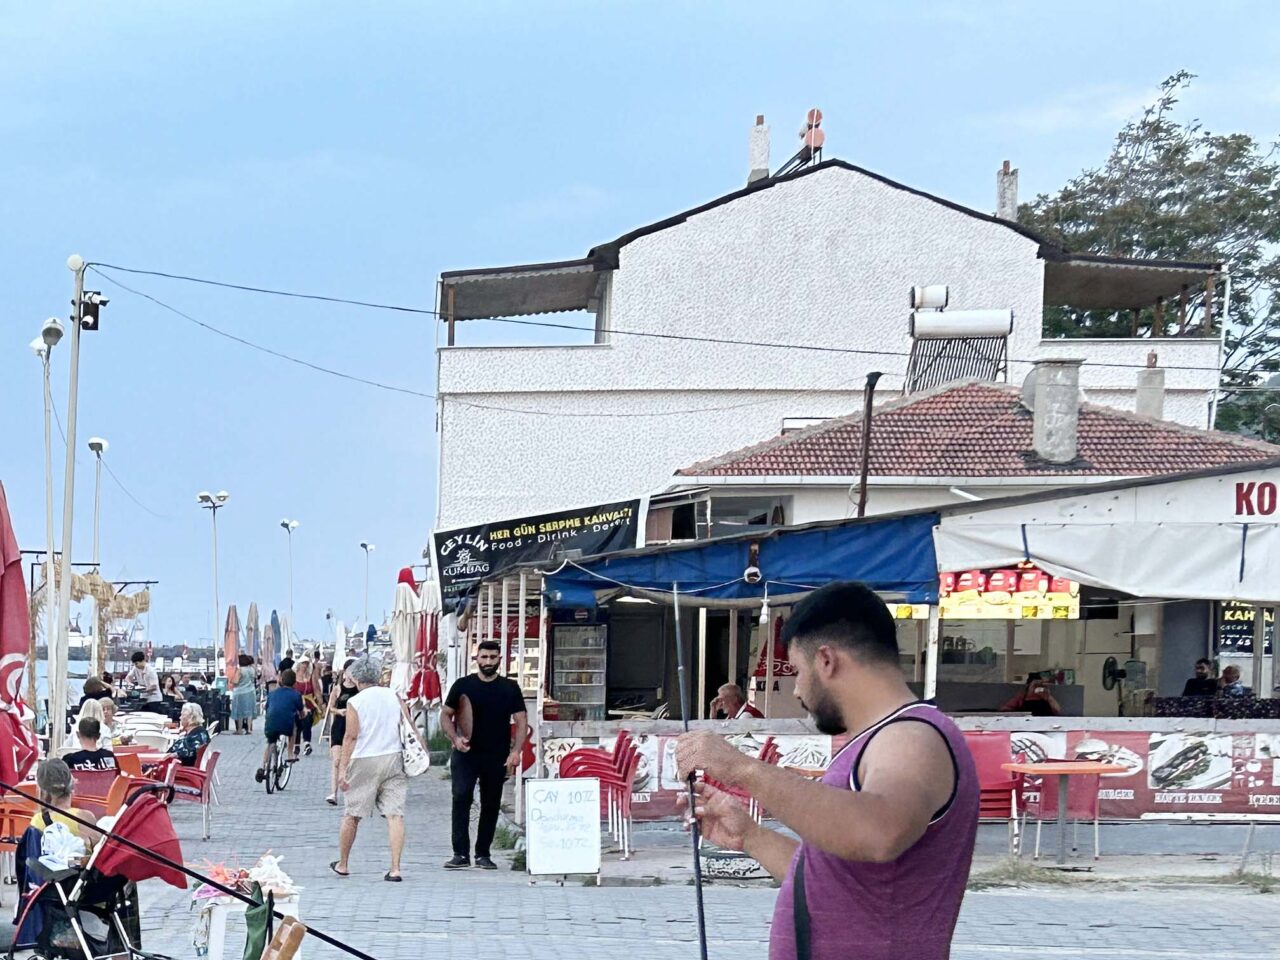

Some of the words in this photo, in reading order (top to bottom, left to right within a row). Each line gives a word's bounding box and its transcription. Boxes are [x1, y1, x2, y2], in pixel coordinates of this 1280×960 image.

[489, 529, 511, 541] HER
[513, 524, 536, 537] GÜN
[491, 538, 522, 551] Food
